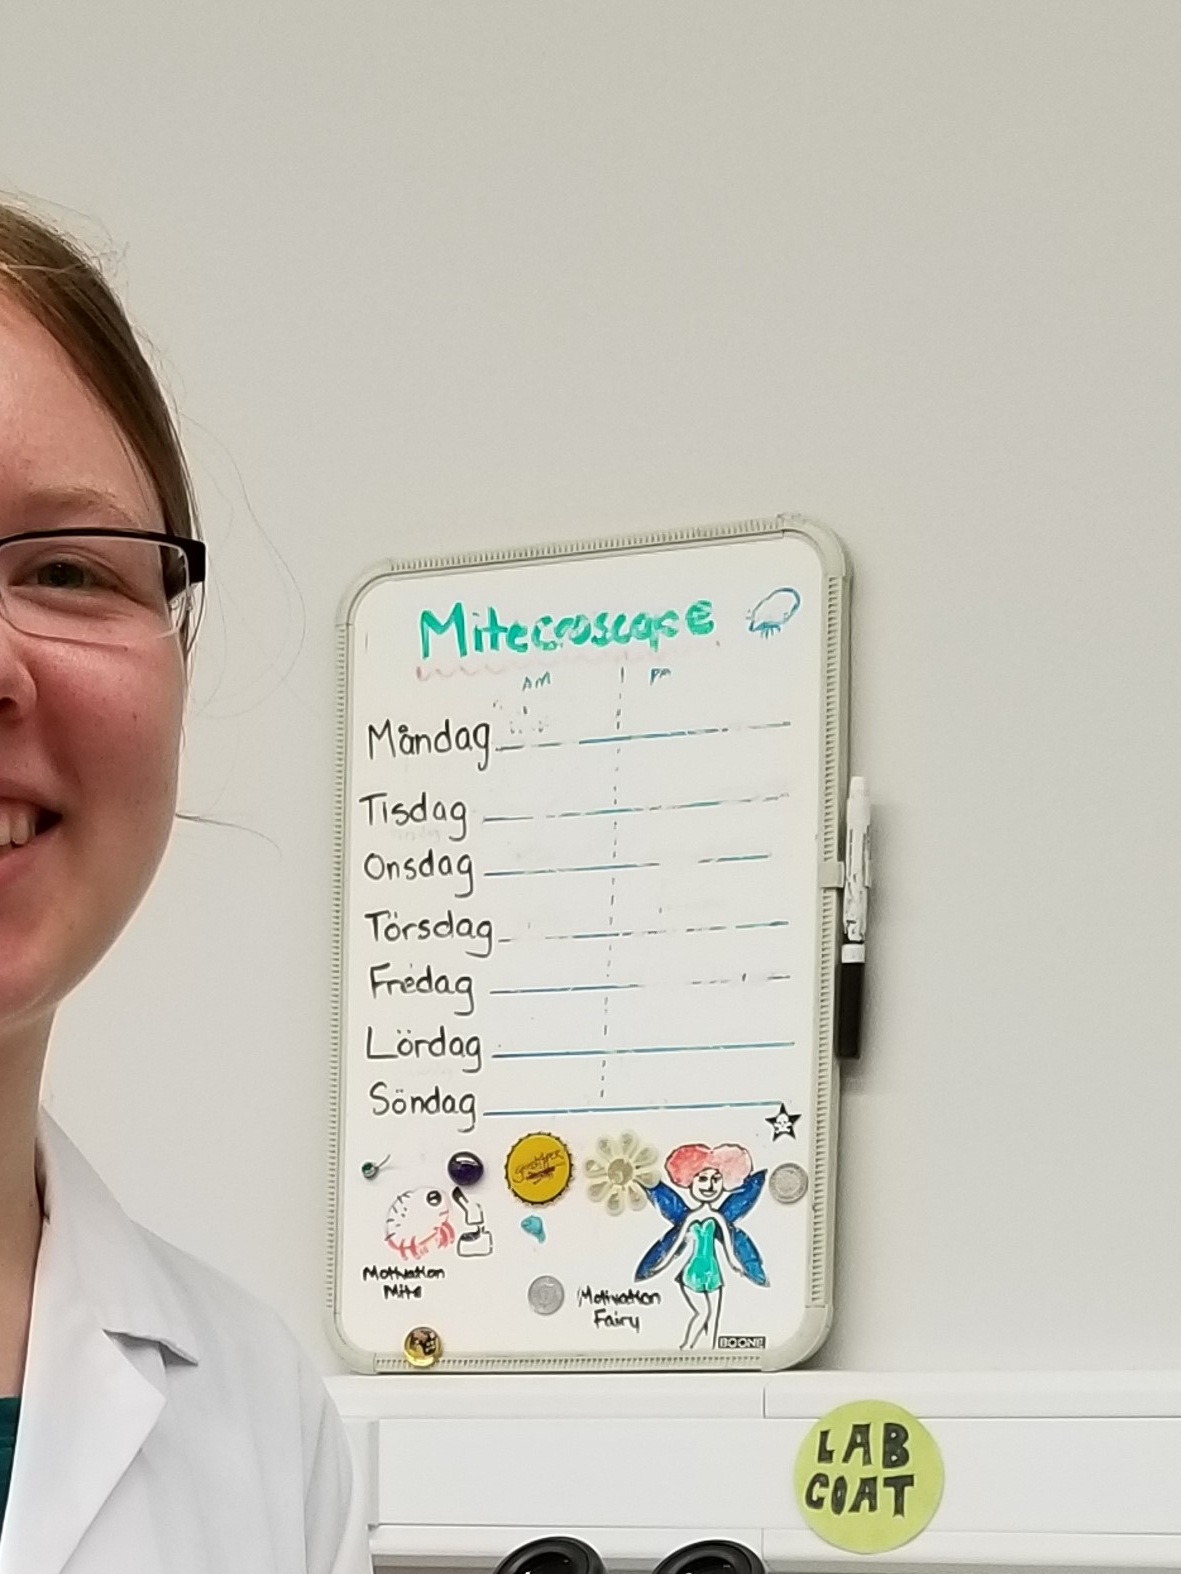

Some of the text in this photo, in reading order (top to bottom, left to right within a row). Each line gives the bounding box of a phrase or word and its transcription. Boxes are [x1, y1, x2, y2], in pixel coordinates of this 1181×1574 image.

[522, 670, 551, 692] AM
[366, 718, 492, 772] Måndag
[358, 790, 468, 843] Tisdag
[363, 847, 474, 899] Onsdag
[363, 909, 493, 959] Törsdag
[369, 961, 475, 1017] Fredag
[366, 1024, 482, 1074] Lördag
[368, 1080, 477, 1134] Söndag
[576, 1284, 662, 1308] Motivation
[593, 1307, 640, 1335] Fairy
[817, 1421, 910, 1470] LAB
[804, 1472, 915, 1519] COAT
